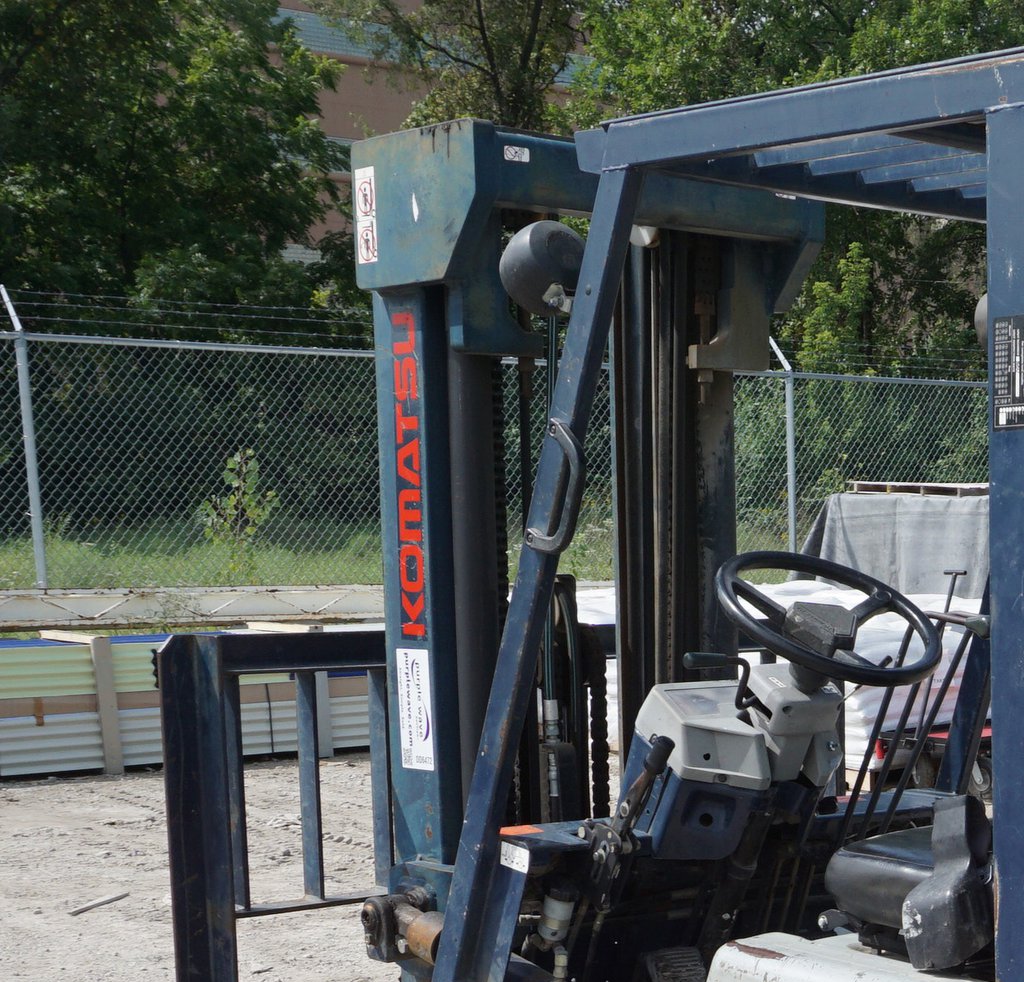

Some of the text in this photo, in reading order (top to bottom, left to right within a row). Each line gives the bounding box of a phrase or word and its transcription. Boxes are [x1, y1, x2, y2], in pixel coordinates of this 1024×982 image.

[391, 312, 425, 636] KOMATSU
[403, 652, 414, 747] purplewave.com
[414, 662, 423, 701] purple
